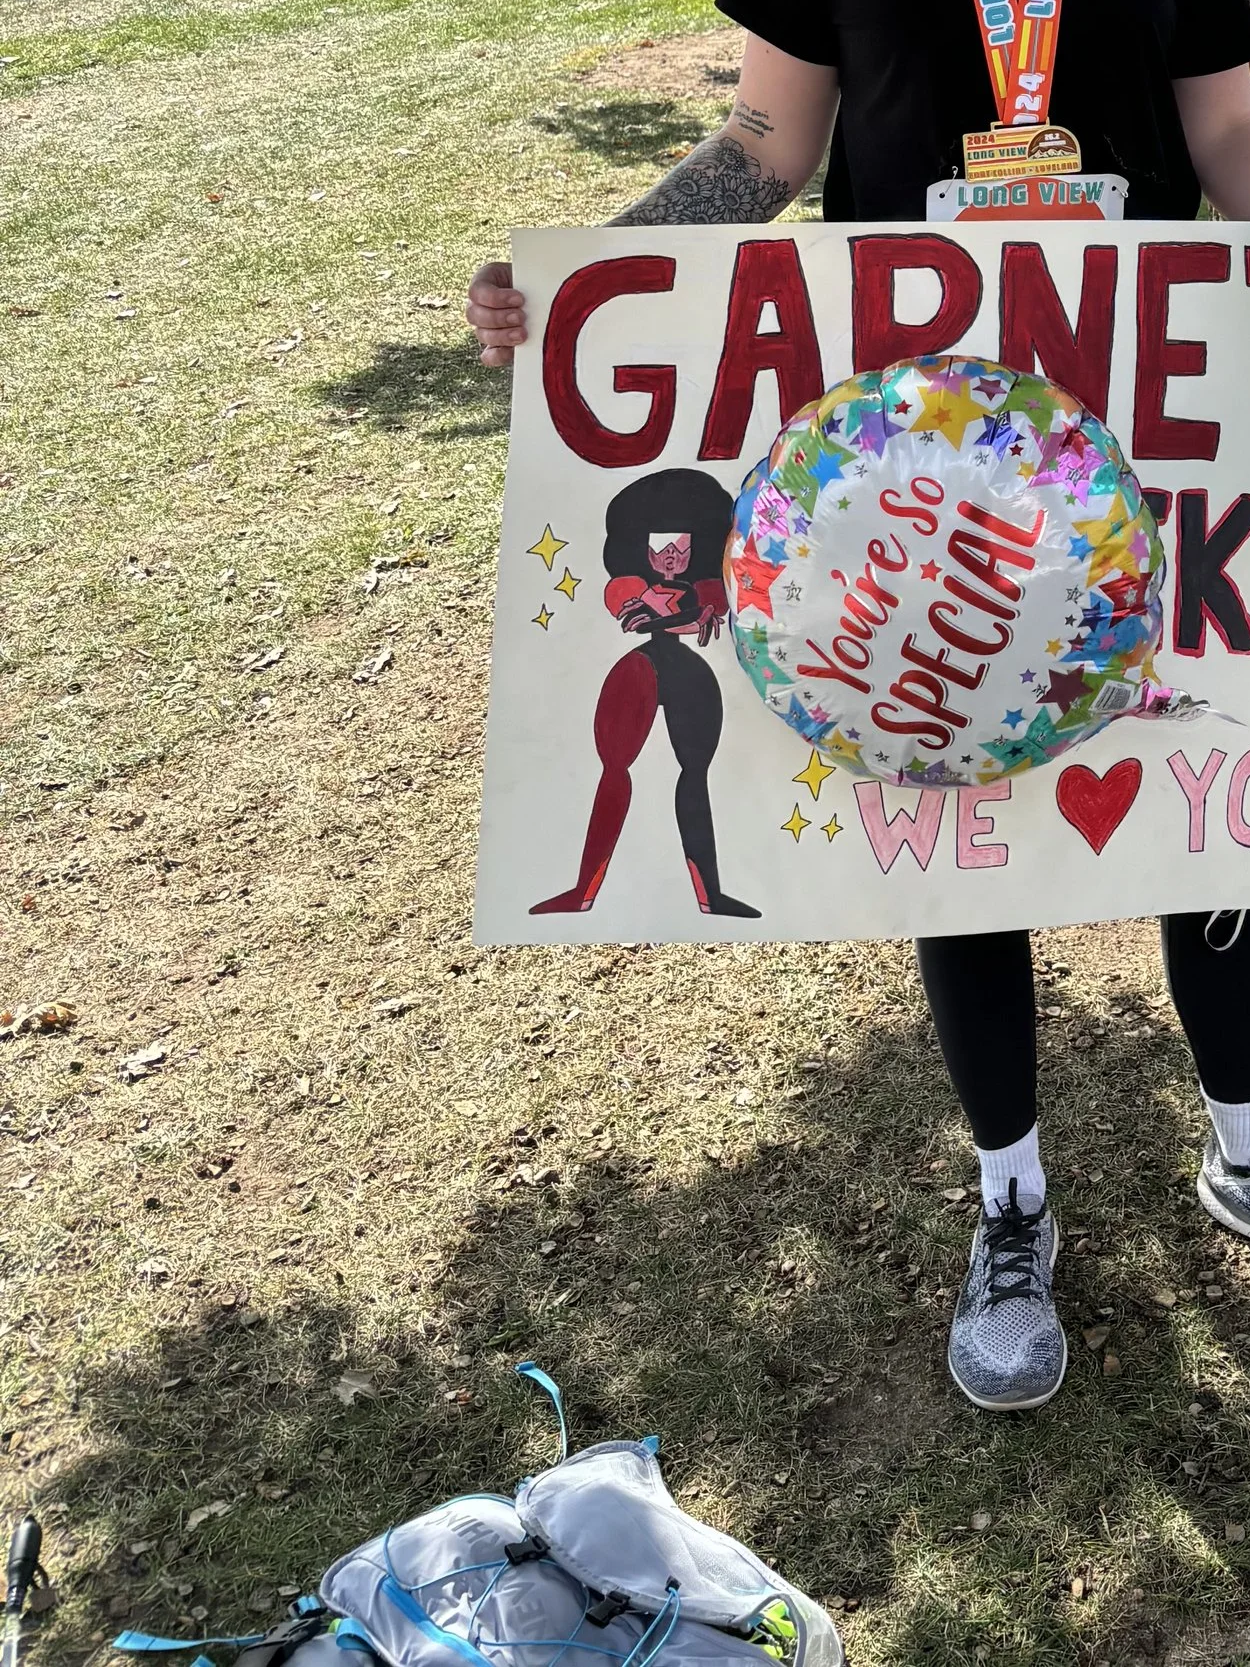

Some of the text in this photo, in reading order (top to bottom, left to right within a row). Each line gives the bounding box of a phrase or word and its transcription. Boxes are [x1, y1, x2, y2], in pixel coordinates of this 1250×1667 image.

[967, 134, 995, 145] 2024
[999, 146, 1027, 157] VIEW
[1038, 180, 1104, 205] VIEW
[798, 473, 947, 696] You're So
[871, 499, 1048, 752] SPECIAL
[854, 777, 1012, 875] WE
